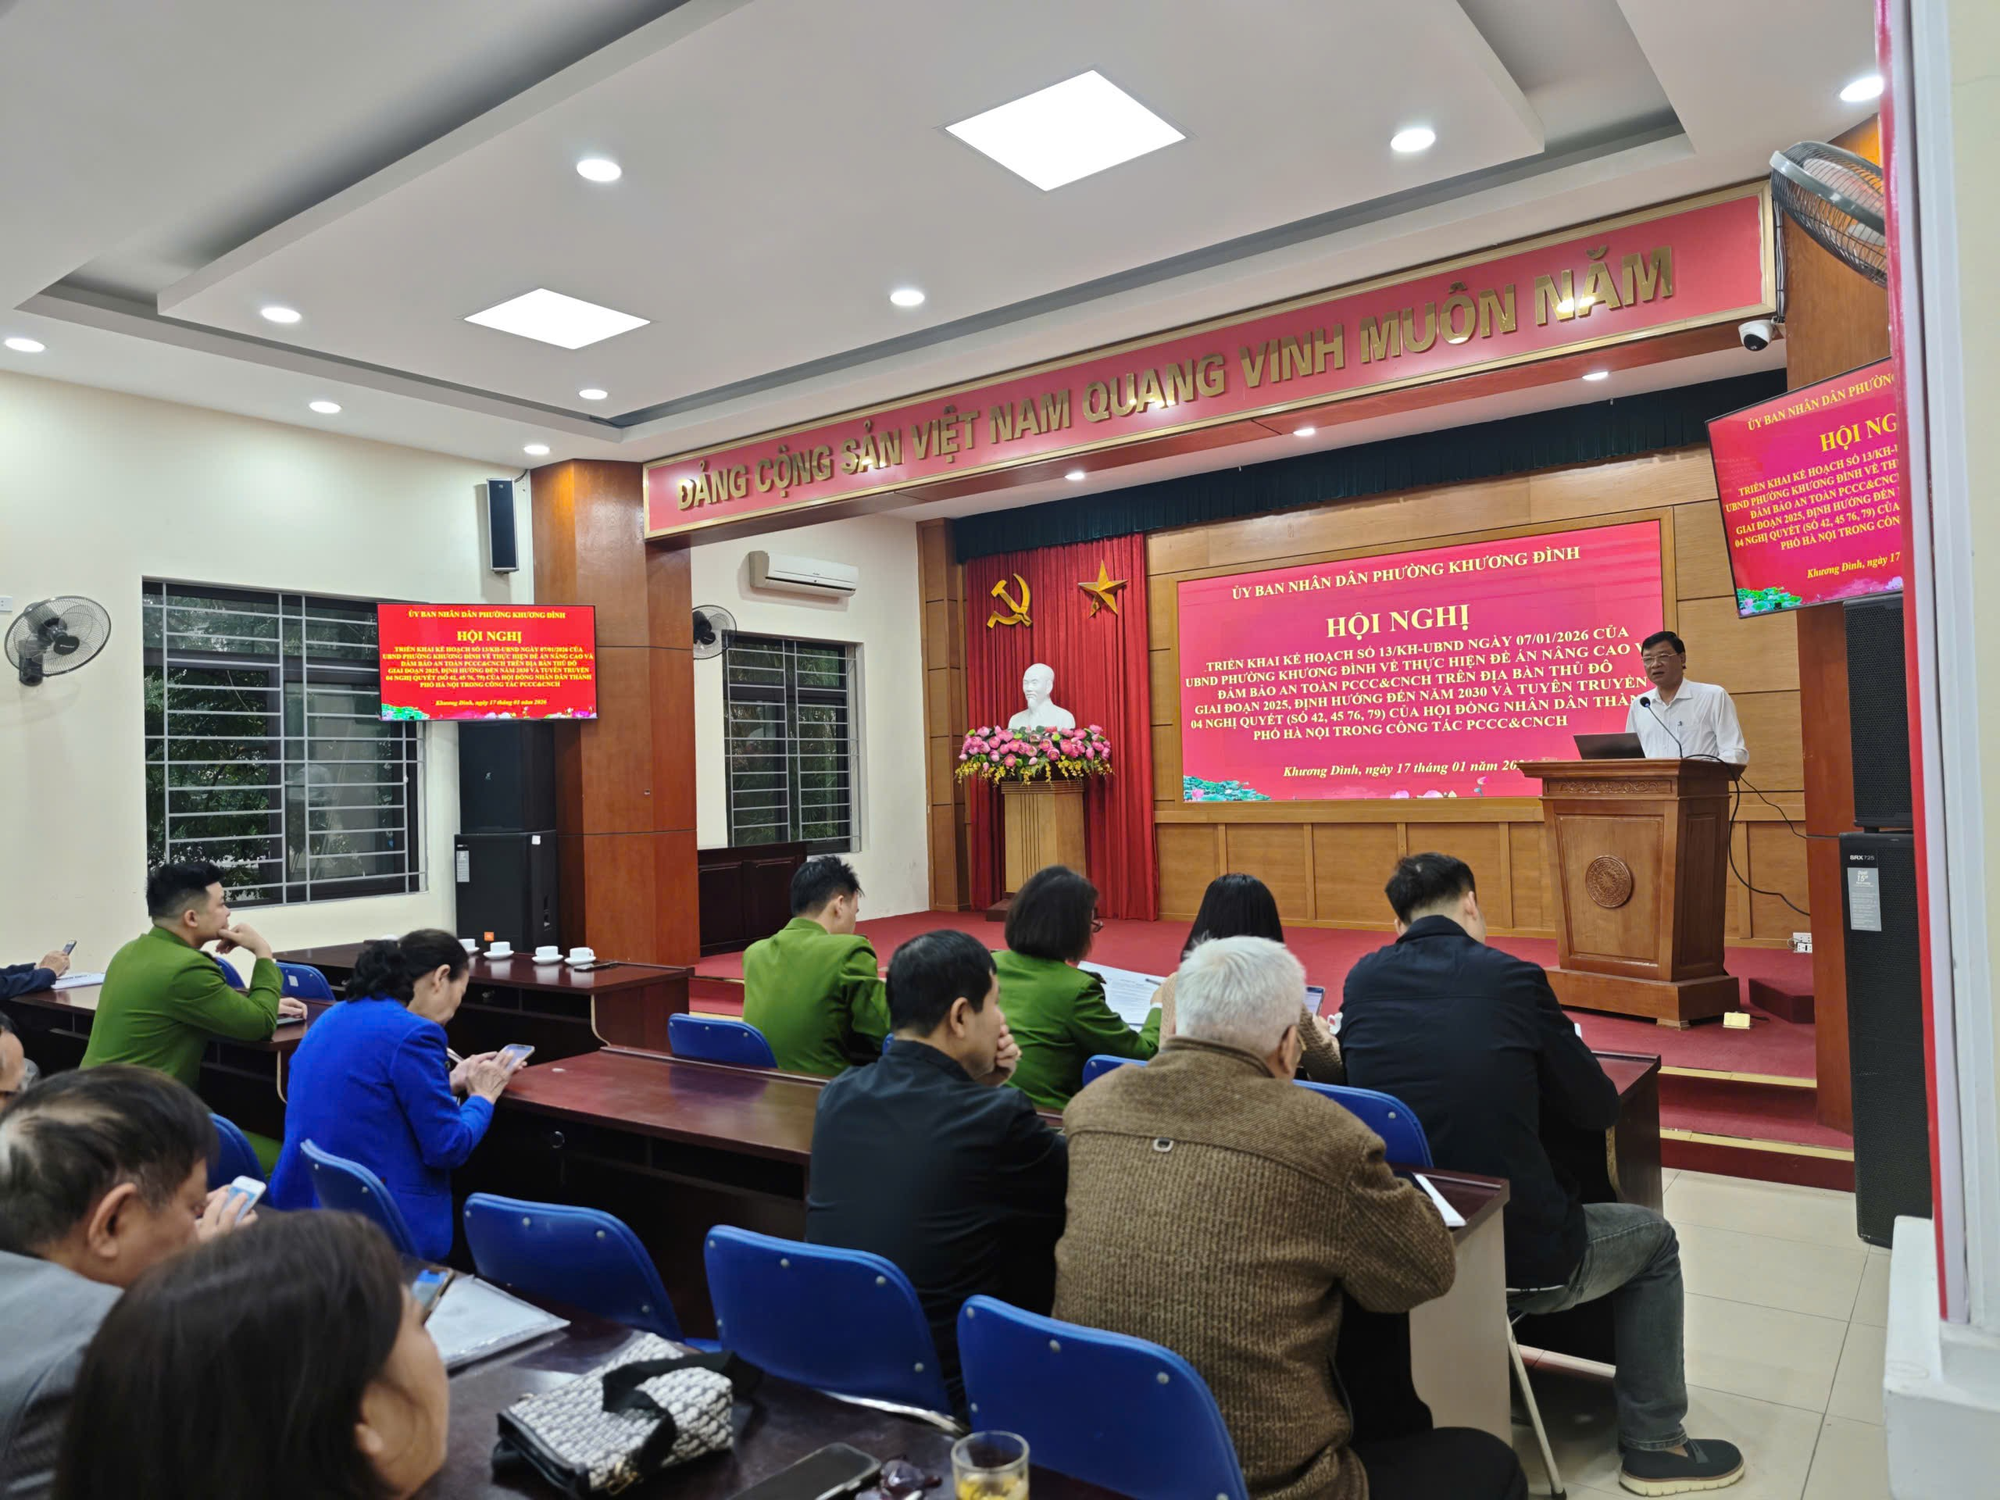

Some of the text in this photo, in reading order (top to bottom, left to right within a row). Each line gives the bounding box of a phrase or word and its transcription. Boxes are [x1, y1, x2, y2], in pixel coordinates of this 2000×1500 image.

[677, 245, 1674, 510] ĐẢNG CỘNG SẢN VIỆT NAM QUANG VINH MUÔN NĂM
[1819, 413, 1897, 452] HỘI NG
[1838, 472, 1900, 496] PCCC&CNC
[1876, 514, 1900, 528] CÔN
[1232, 546, 1580, 600] ỦY BAN NHÂN DÂN PHƯỜNG KHƯƠNG ĐÌNH
[456, 630, 522, 644] HỘI NGHỊ
[1326, 604, 1470, 640] HỘI NGHỊ
[1247, 656, 1280, 668] KHAI
[1304, 650, 1354, 664] HOẠCH
[1380, 640, 1464, 657] 13/KH-UBND
[1468, 634, 1512, 650] NGÀY
[1516, 629, 1589, 646] 07/01/2026
[1593, 624, 1629, 640] CỦA
[1186, 676, 1218, 688] UBND
[1221, 671, 1275, 684] PHƯỜNG
[1278, 666, 1338, 680] KHƯƠNG
[1341, 662, 1376, 676] ĐÌNH
[1402, 657, 1444, 672] THỰC
[1448, 654, 1486, 668] HIỆN
[1516, 649, 1538, 662] ÁN
[1542, 646, 1589, 660] NÂNG
[1593, 644, 1630, 656] CAO
[1250, 684, 1276, 698] BẢO
[1280, 684, 1298, 696] AN
[1300, 680, 1338, 694] TOÀN
[1342, 675, 1432, 691] PCCC&CNCH
[1436, 669, 1476, 684] TRÊN
[1480, 670, 1508, 684] ĐỊA
[1512, 665, 1544, 679] BÀN
[1549, 662, 1584, 677] THỦ
[1588, 659, 1613, 674] ĐÔ
[1190, 720, 1202, 729] 04
[1206, 718, 1237, 730] NGHỊ
[1311, 712, 1328, 724] 42,
[1330, 711, 1344, 722] 45
[1348, 710, 1364, 721] 76,
[1368, 708, 1386, 720] 79)
[1389, 705, 1419, 718] CỦA
[1424, 704, 1451, 718] HỘI
[1504, 697, 1550, 712] NHÂN
[1554, 695, 1588, 710] DÂN
[1194, 704, 1222, 714] GIAI
[1224, 701, 1260, 714] ĐOẠN
[1263, 700, 1292, 711] 2025,
[1294, 696, 1328, 710] ĐỊNH
[1332, 692, 1383, 706] HƯỚNG
[1420, 688, 1454, 700] NĂM
[1458, 686, 1488, 698] 2030
[1491, 682, 1514, 696] VÀ
[1517, 678, 1572, 694] TUYÊN
[1284, 726, 1302, 739] HÀ
[1306, 726, 1330, 740] NỘI
[1333, 724, 1383, 737] TRONG
[1386, 720, 1428, 734] CÔNG
[1432, 718, 1462, 732] TÁC
[1466, 715, 1568, 731] PCCC&CNCH
[1283, 766, 1328, 778] Khương
[1330, 764, 1362, 776] Đình,
[1365, 764, 1394, 776] ngày
[1397, 762, 1412, 774] 17
[1414, 762, 1448, 775] tháng
[1452, 762, 1466, 773] 01
[1470, 760, 1498, 772] năm
